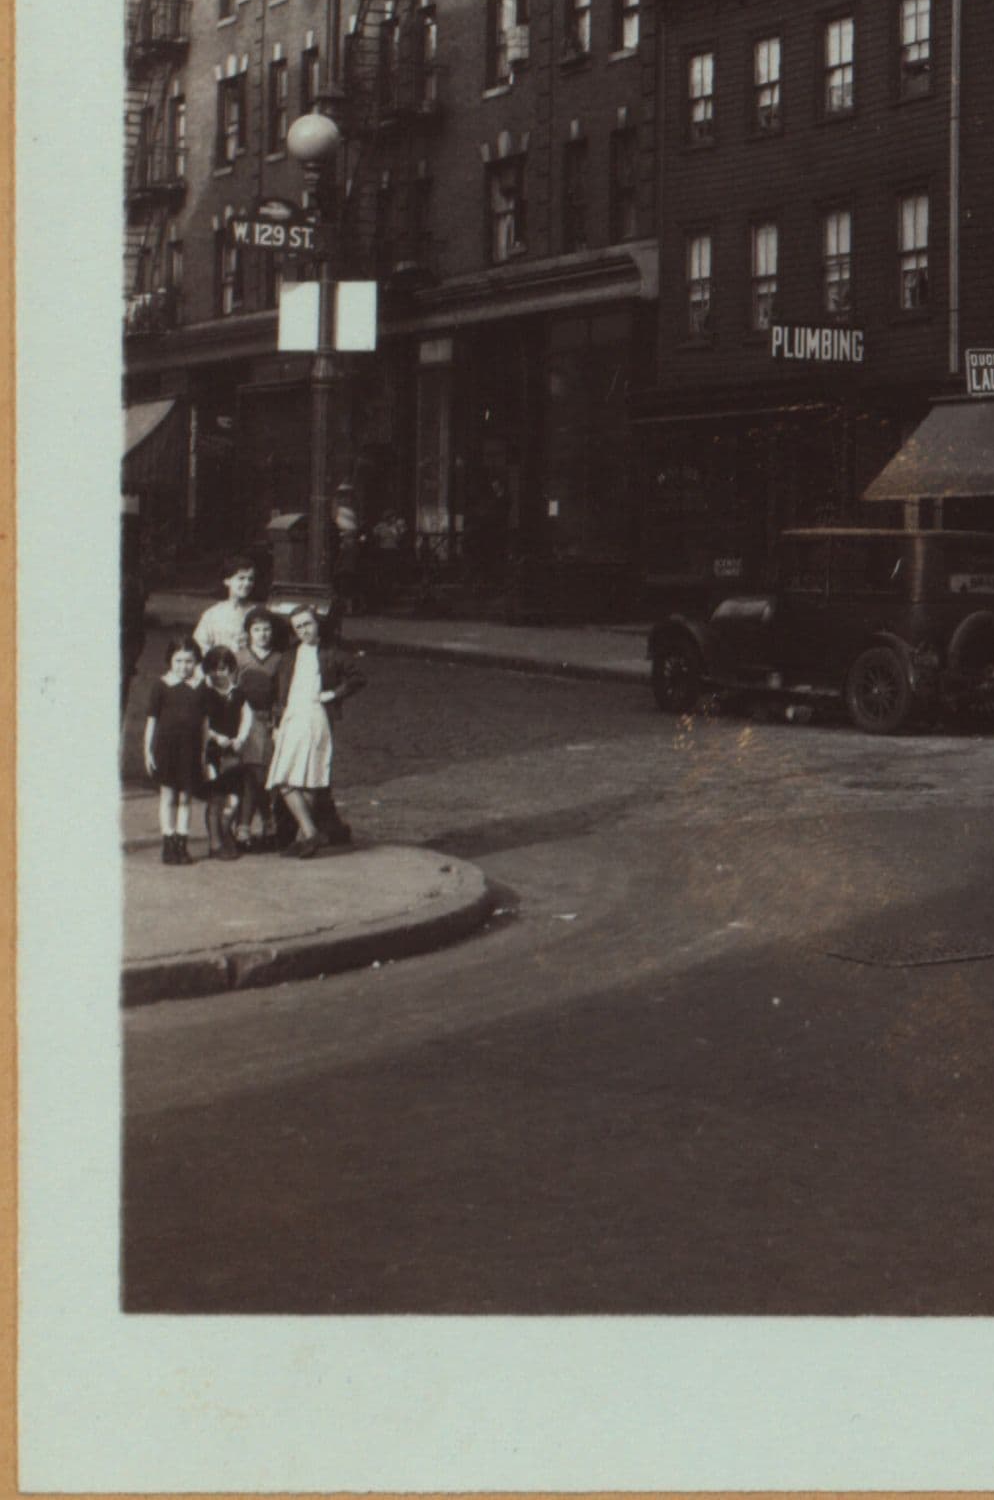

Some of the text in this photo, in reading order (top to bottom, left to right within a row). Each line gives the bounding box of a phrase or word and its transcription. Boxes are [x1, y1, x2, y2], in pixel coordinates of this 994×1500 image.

[233, 221, 314, 249] W. 129 ST.
[771, 325, 865, 362] PLUMBING
